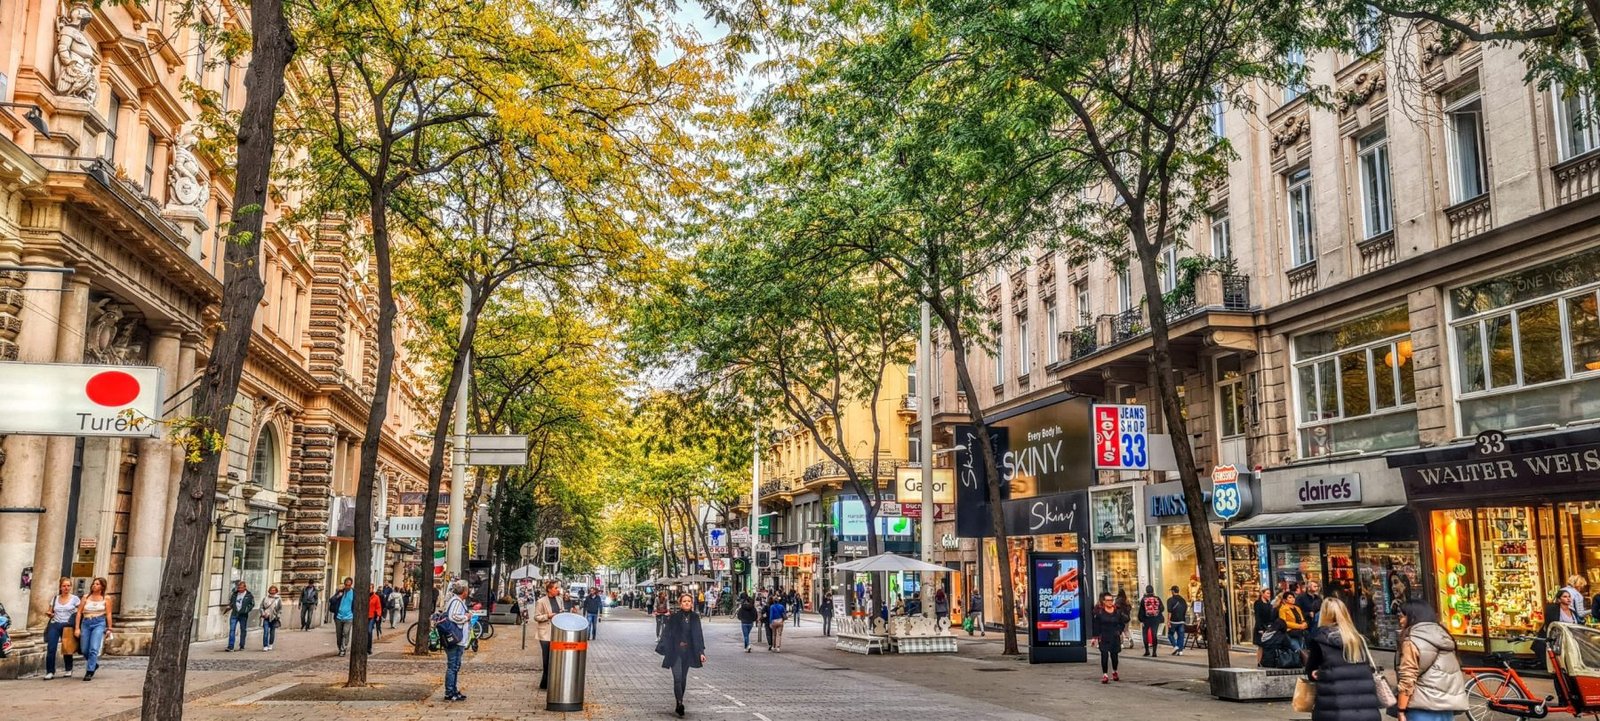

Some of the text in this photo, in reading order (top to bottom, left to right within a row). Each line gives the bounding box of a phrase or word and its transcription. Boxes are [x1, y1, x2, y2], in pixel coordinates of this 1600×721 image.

[1517, 275, 1543, 291] ONE
[76, 413, 140, 431] Turek
[1121, 407, 1144, 420] JEANS
[1028, 431, 1041, 441] Every
[1042, 427, 1055, 438] Body
[1121, 420, 1145, 432] SHOP
[1121, 433, 1147, 467] 33
[1479, 434, 1505, 455] 33
[1003, 440, 1064, 480] SKINY.
[1418, 460, 1517, 485] WALTER
[905, 478, 947, 492] Gaor
[1299, 478, 1351, 502] claire's
[1216, 488, 1237, 511] 33
[1030, 502, 1077, 530] Skiny
[1040, 600, 1053, 608] FÜR
